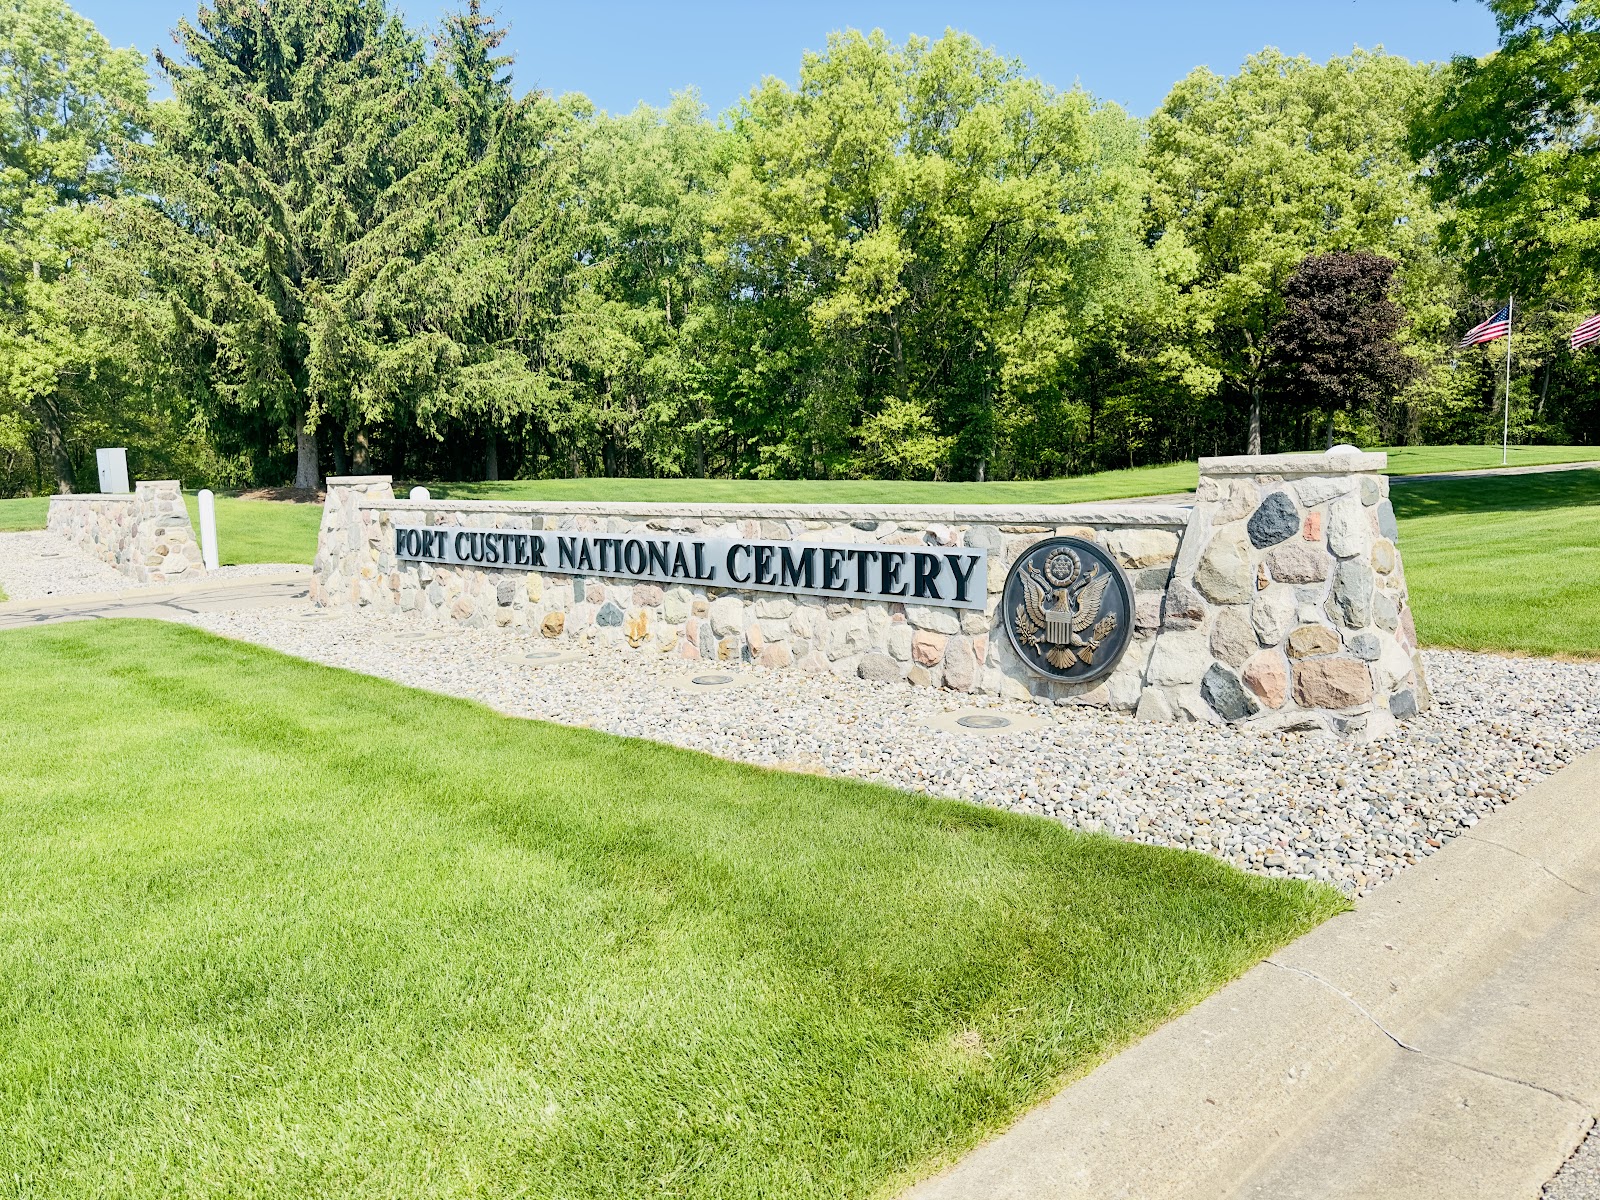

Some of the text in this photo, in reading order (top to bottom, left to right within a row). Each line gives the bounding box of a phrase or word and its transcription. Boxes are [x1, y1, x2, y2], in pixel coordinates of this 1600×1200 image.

[395, 528, 981, 602] FORT CUSTER NATIONAL CEMETERY
